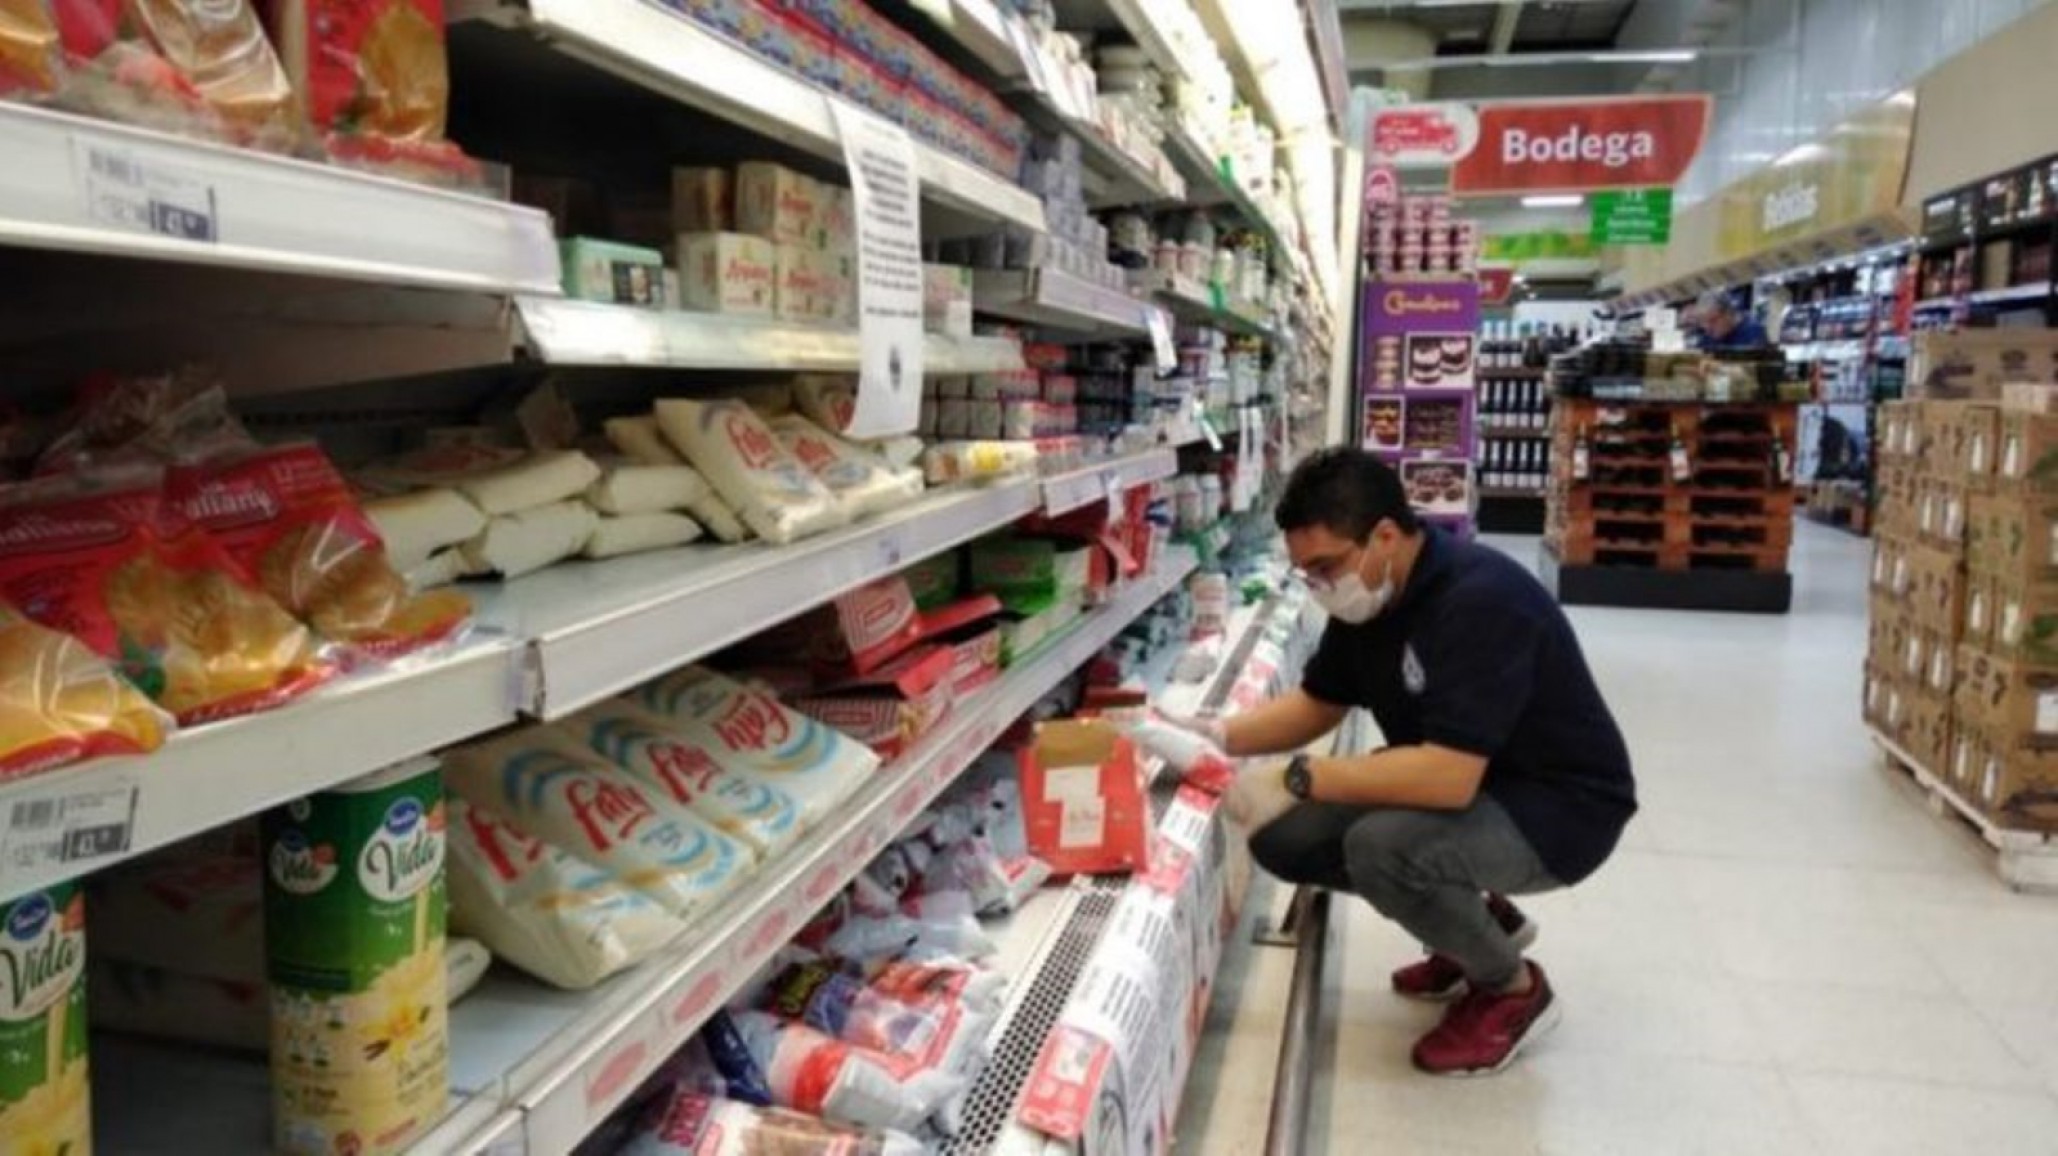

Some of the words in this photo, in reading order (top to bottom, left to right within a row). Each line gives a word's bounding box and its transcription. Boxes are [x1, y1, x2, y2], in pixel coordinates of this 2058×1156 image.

[1501, 126, 1654, 167] Bodega
[364, 830, 437, 893] Vida
[0, 928, 74, 1010] Vida
